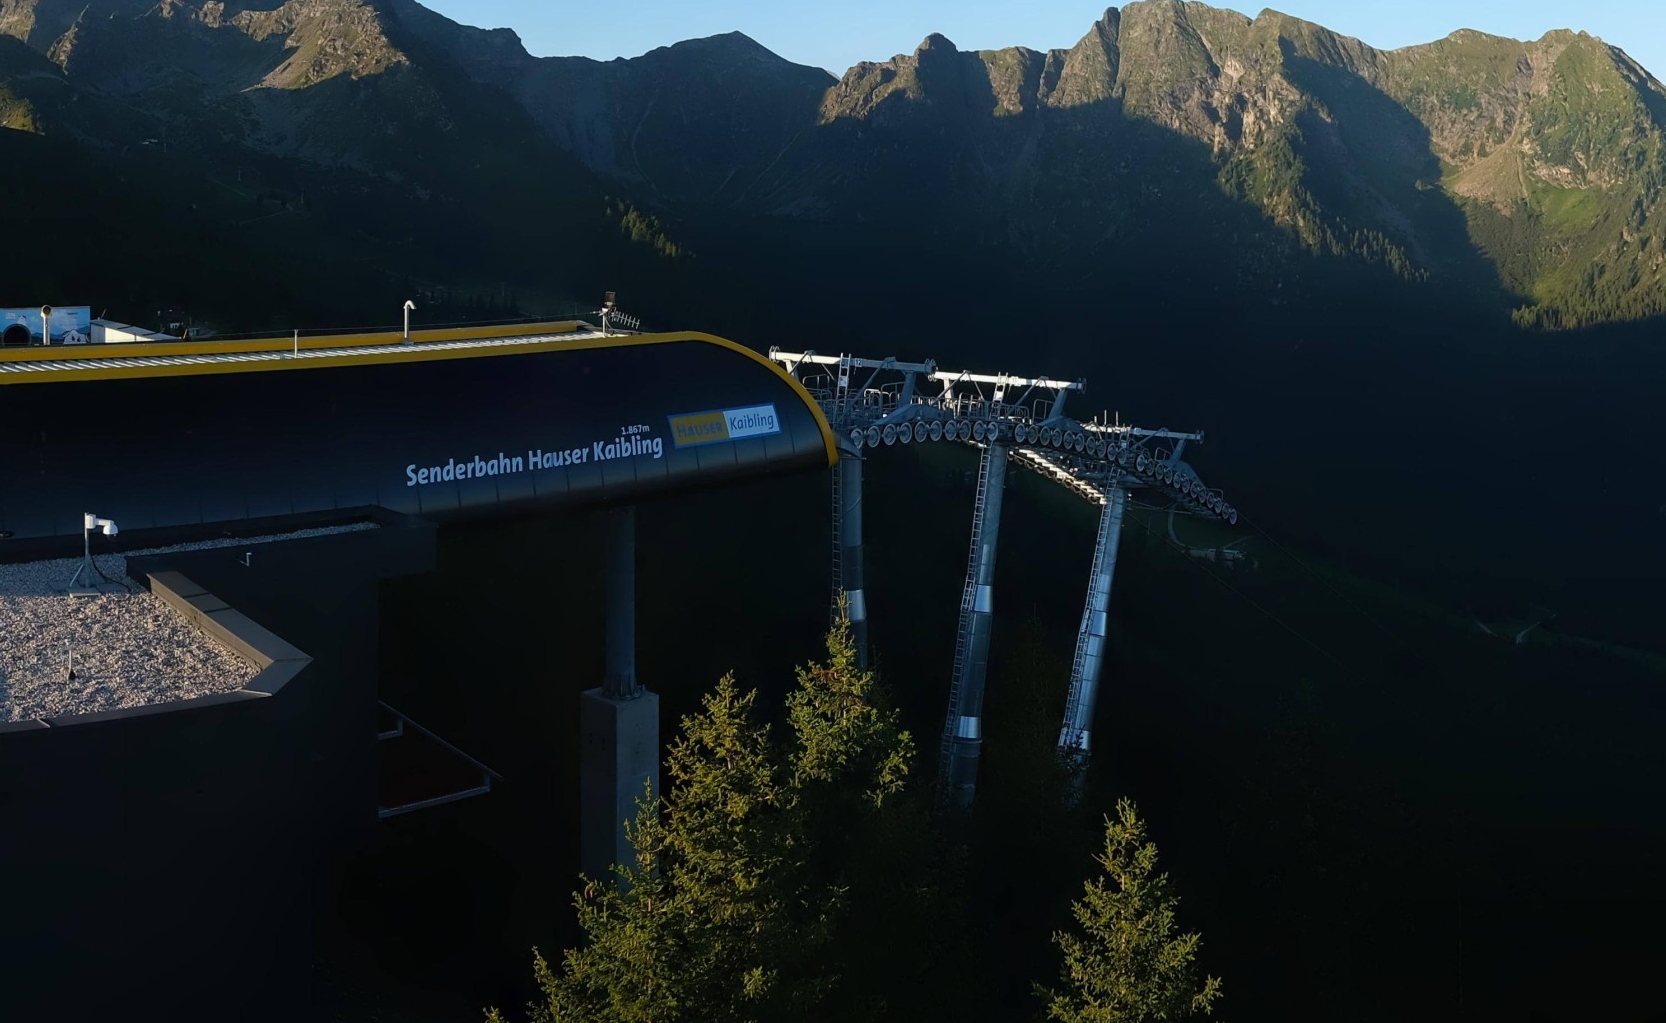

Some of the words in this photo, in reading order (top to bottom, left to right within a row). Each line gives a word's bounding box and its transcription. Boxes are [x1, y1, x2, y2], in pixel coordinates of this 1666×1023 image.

[676, 421, 724, 438] HAUSER
[730, 413, 775, 432] Kaibling
[406, 452, 523, 486] Senderbahn
[528, 446, 590, 470] Hauser
[593, 434, 663, 461] Kaibling
